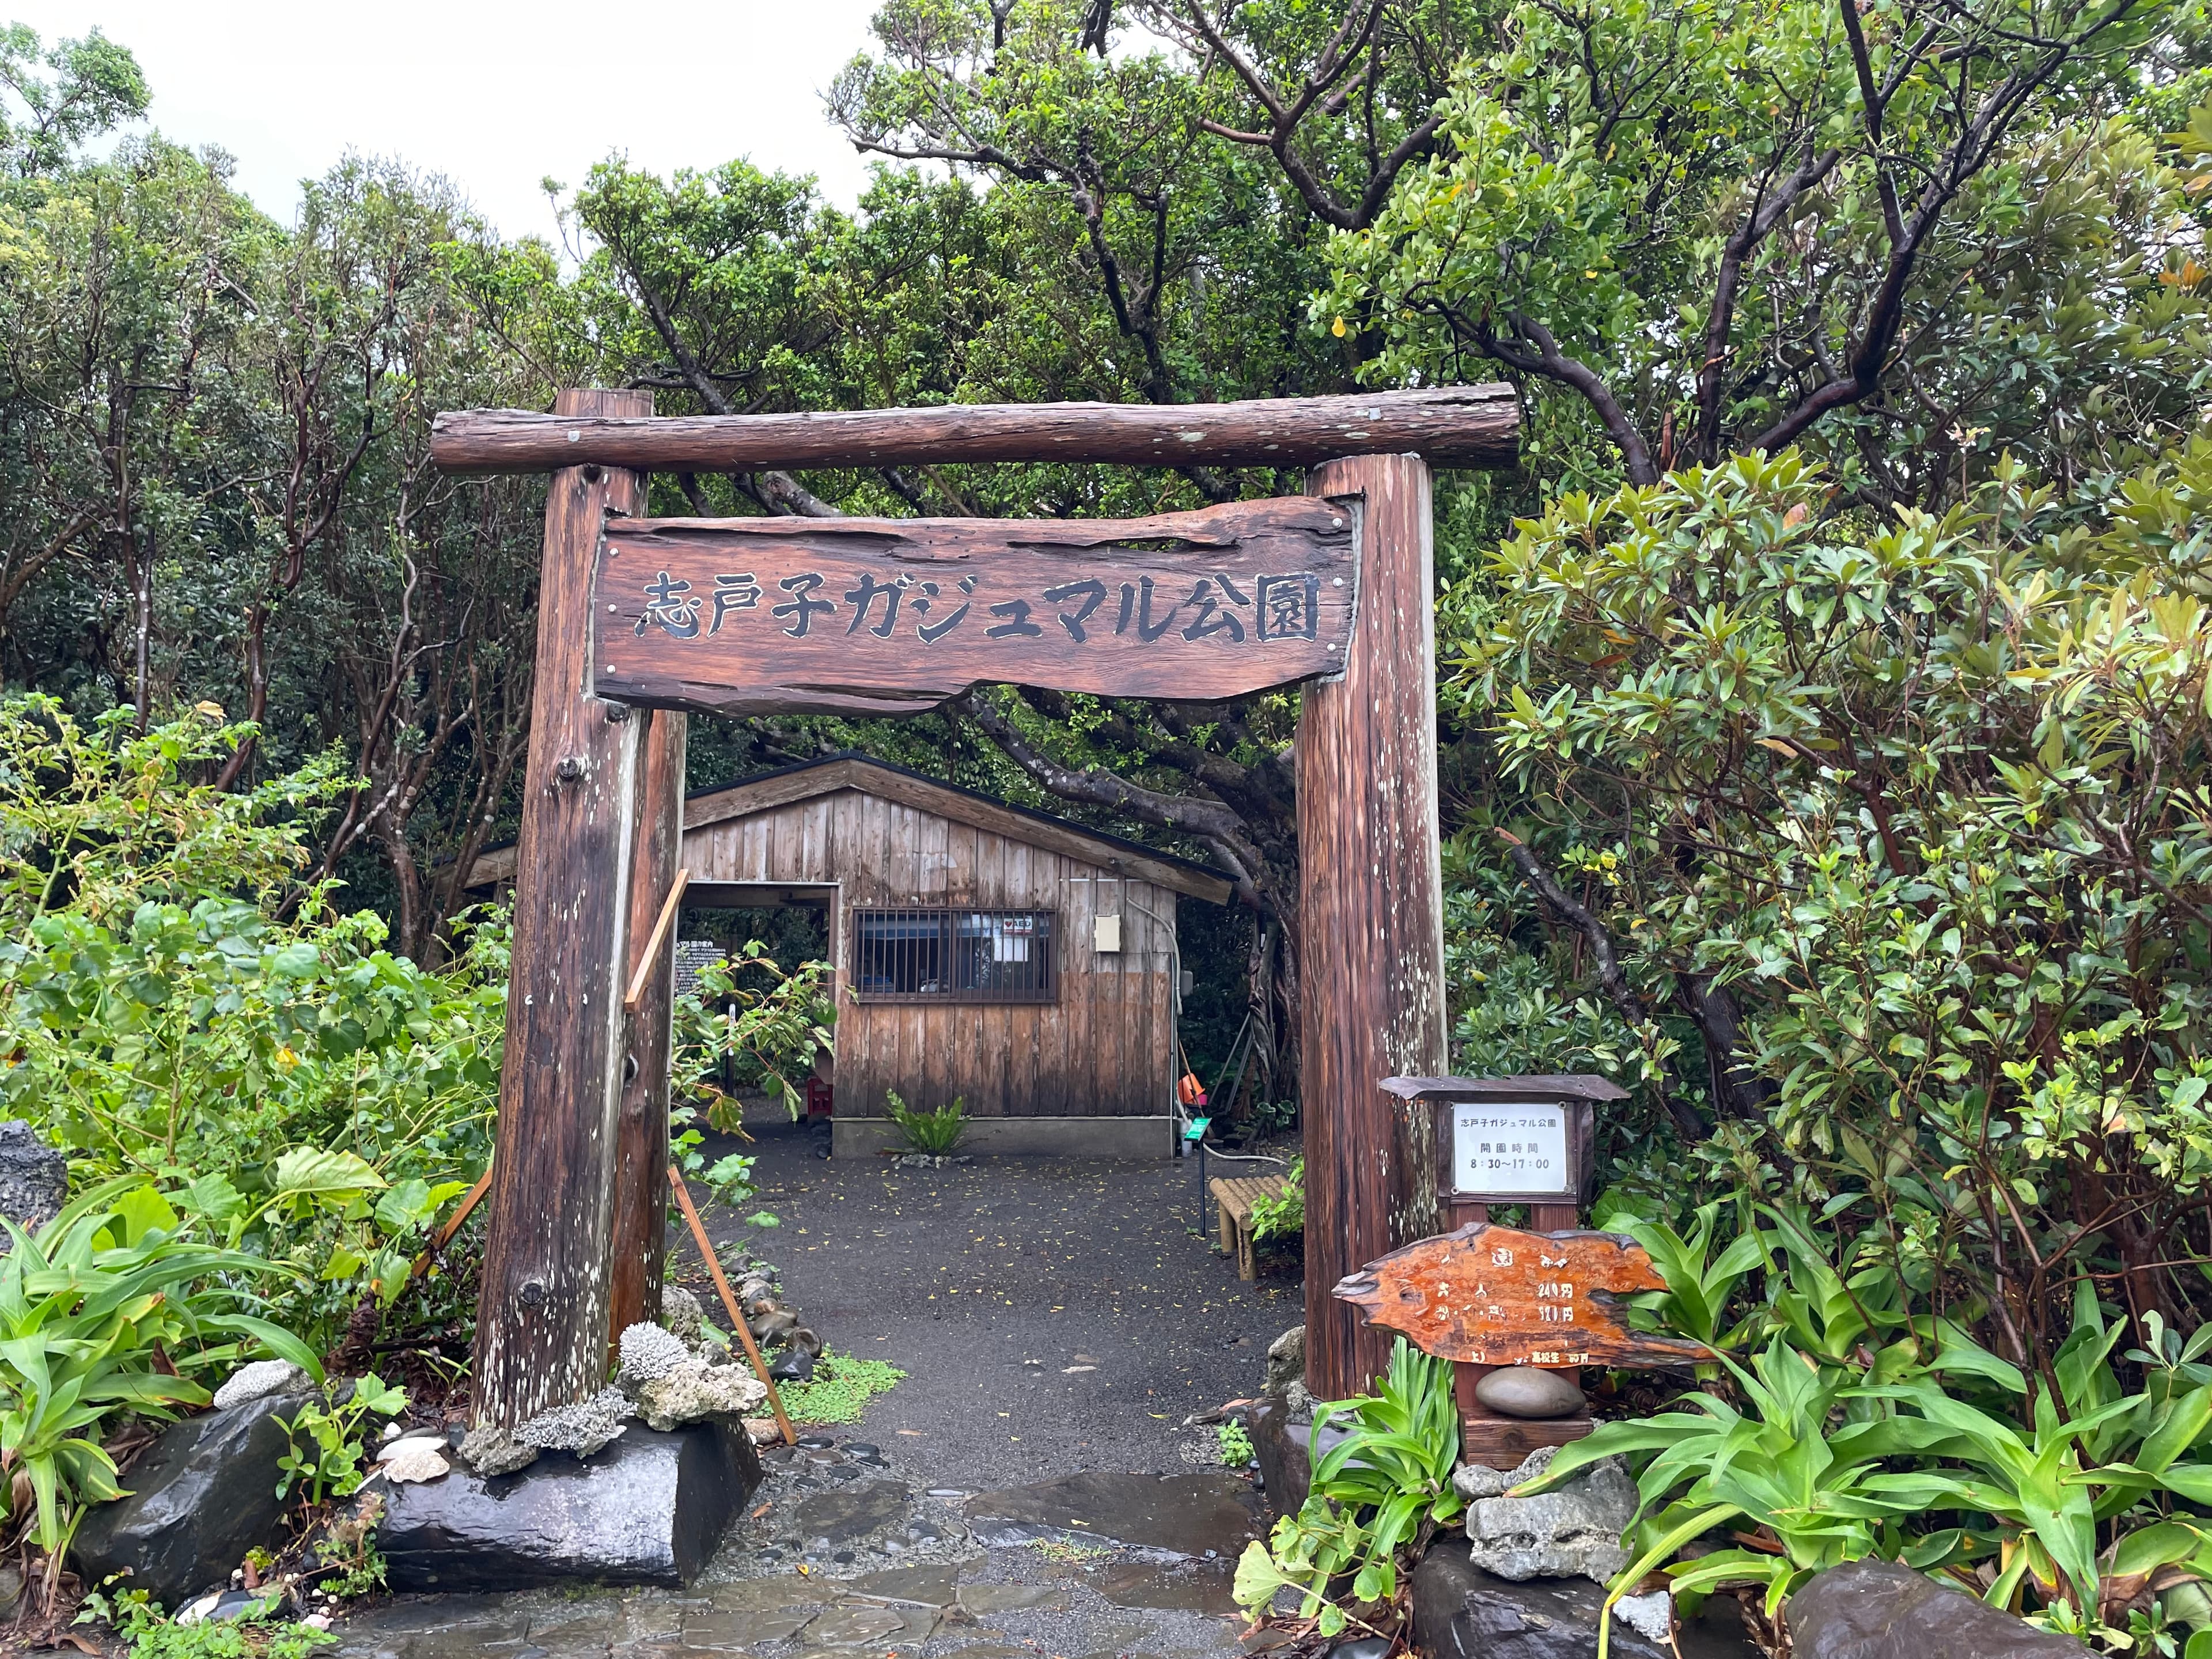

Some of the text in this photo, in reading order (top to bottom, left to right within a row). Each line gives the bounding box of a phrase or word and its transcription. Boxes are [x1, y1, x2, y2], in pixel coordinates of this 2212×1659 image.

[634, 571, 1320, 644] 志戸子ガジュマル公園
[1461, 1119, 1556, 1127] 志戸子ガジュマル公園
